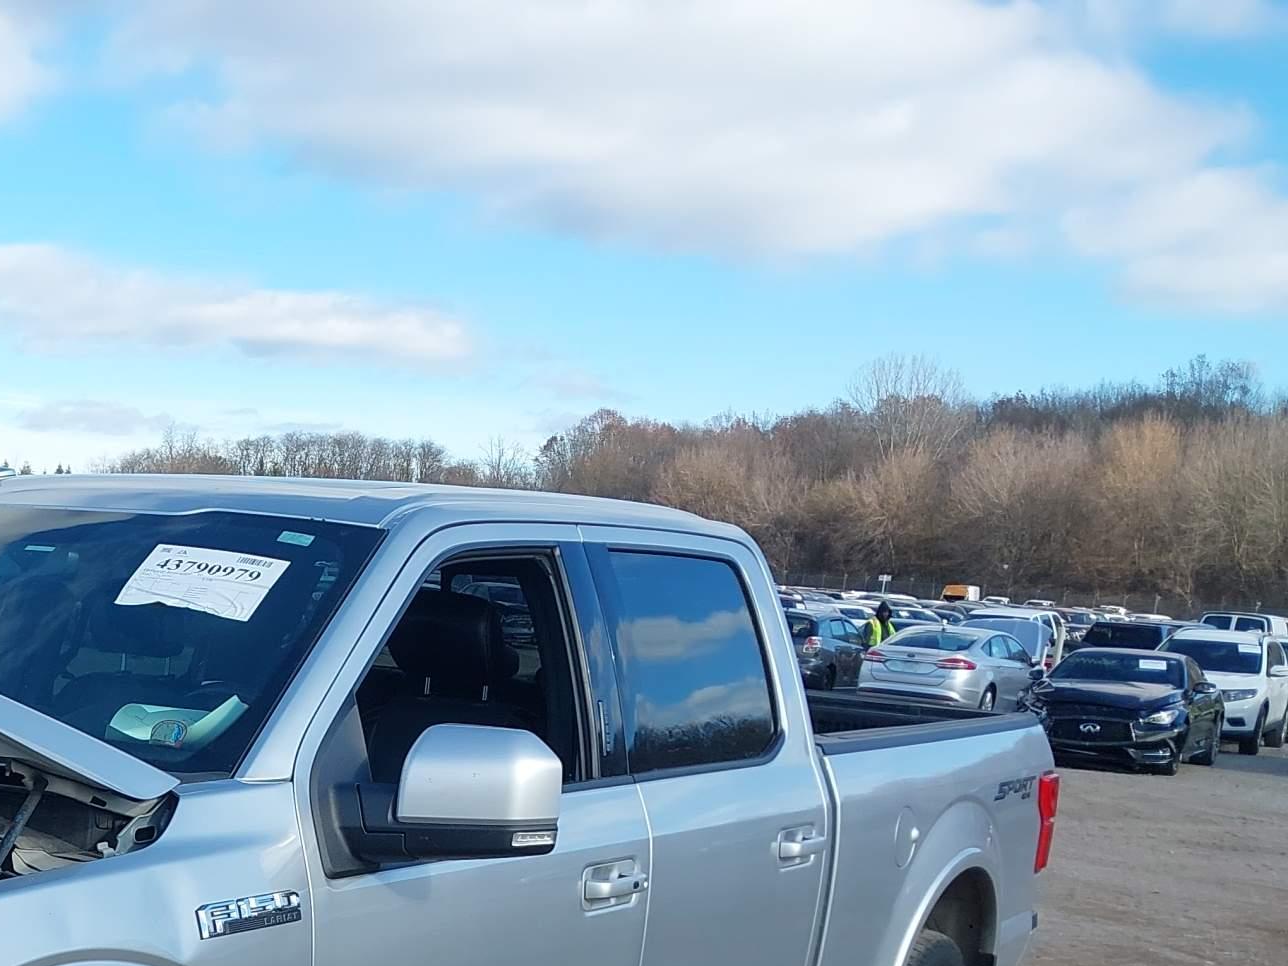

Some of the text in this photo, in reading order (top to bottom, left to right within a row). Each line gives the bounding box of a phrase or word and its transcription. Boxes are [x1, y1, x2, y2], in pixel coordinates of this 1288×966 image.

[155, 557, 262, 582] 43790979
[993, 775, 1037, 801] SPORT
[263, 911, 299, 927] LARIAT
